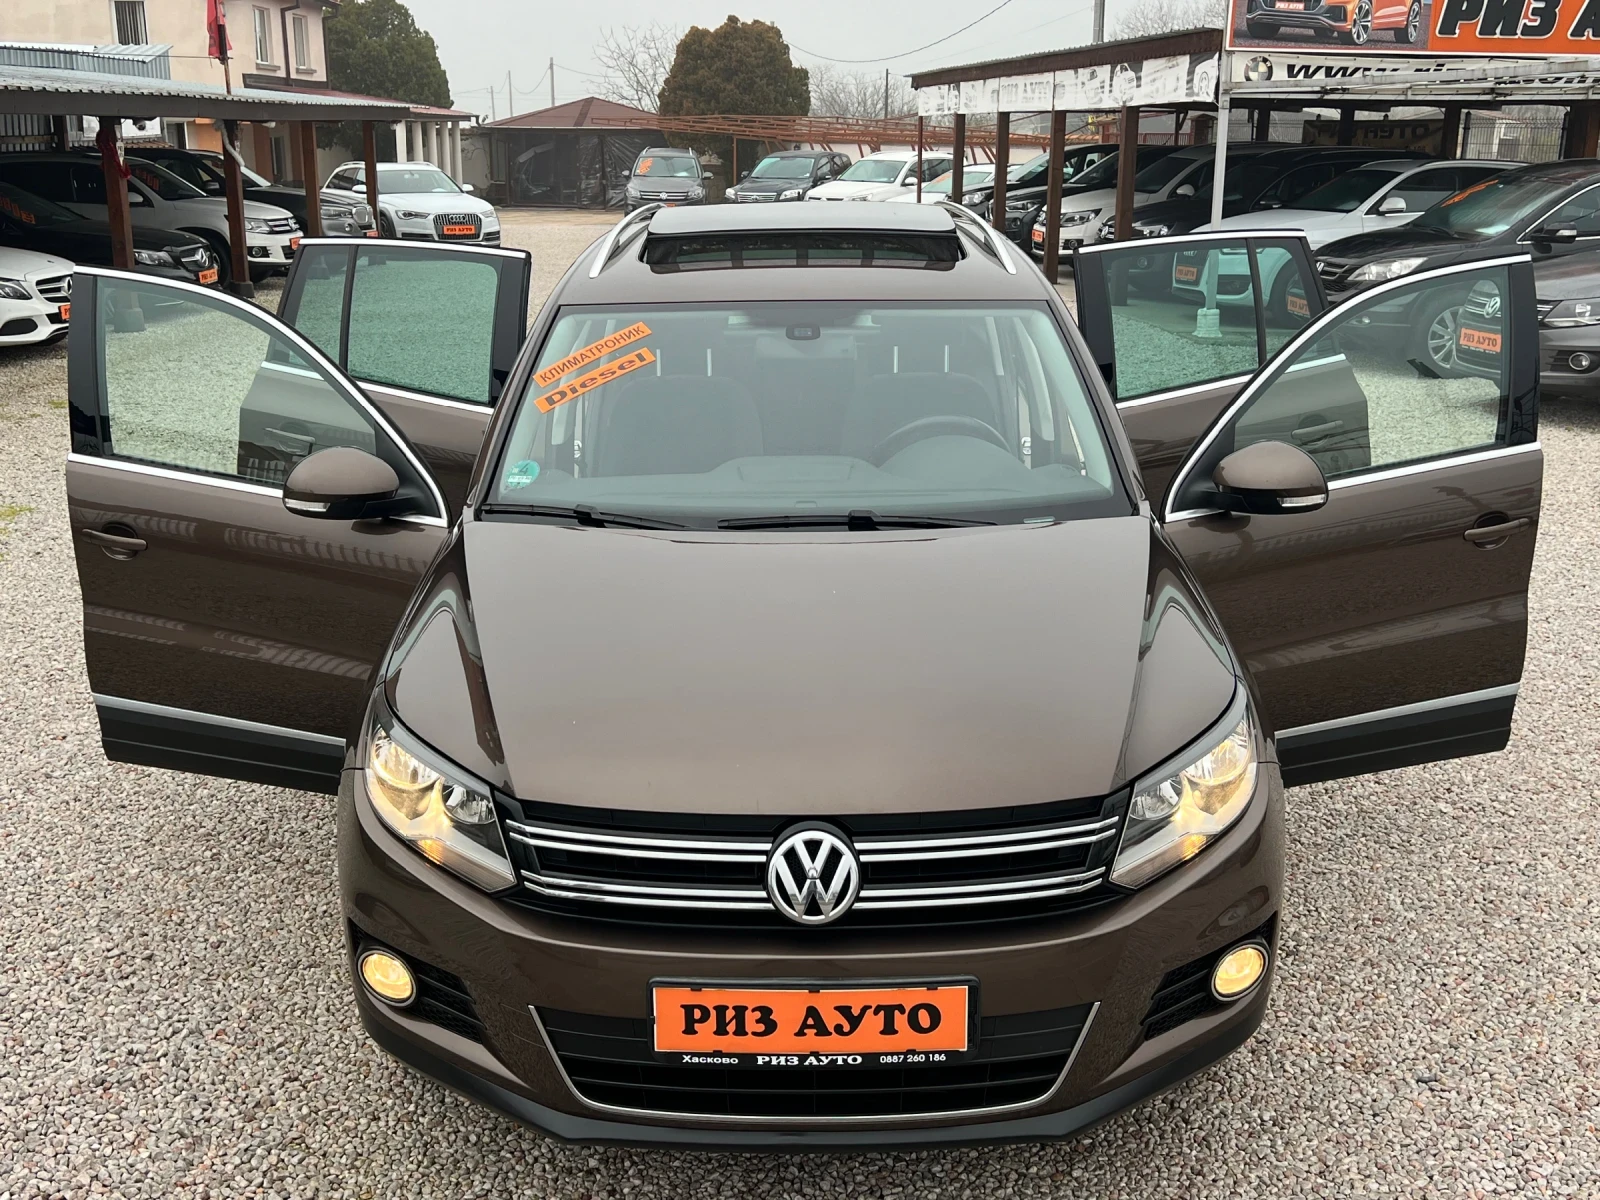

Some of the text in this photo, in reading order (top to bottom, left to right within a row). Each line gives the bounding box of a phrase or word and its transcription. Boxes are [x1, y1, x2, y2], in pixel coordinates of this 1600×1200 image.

[1436, 0, 1562, 38] РИЗ
[1476, 335, 1498, 347] АУТО
[539, 325, 645, 383] КЛИМАТРОНИК
[545, 352, 647, 406] Diesel
[519, 462, 530, 475] 4
[680, 1002, 942, 1037] РИЗ АУТО
[682, 1054, 738, 1064] Хасково
[756, 1055, 863, 1066] РИЗ АУТО
[879, 1053, 946, 1064] 0887 260 186
